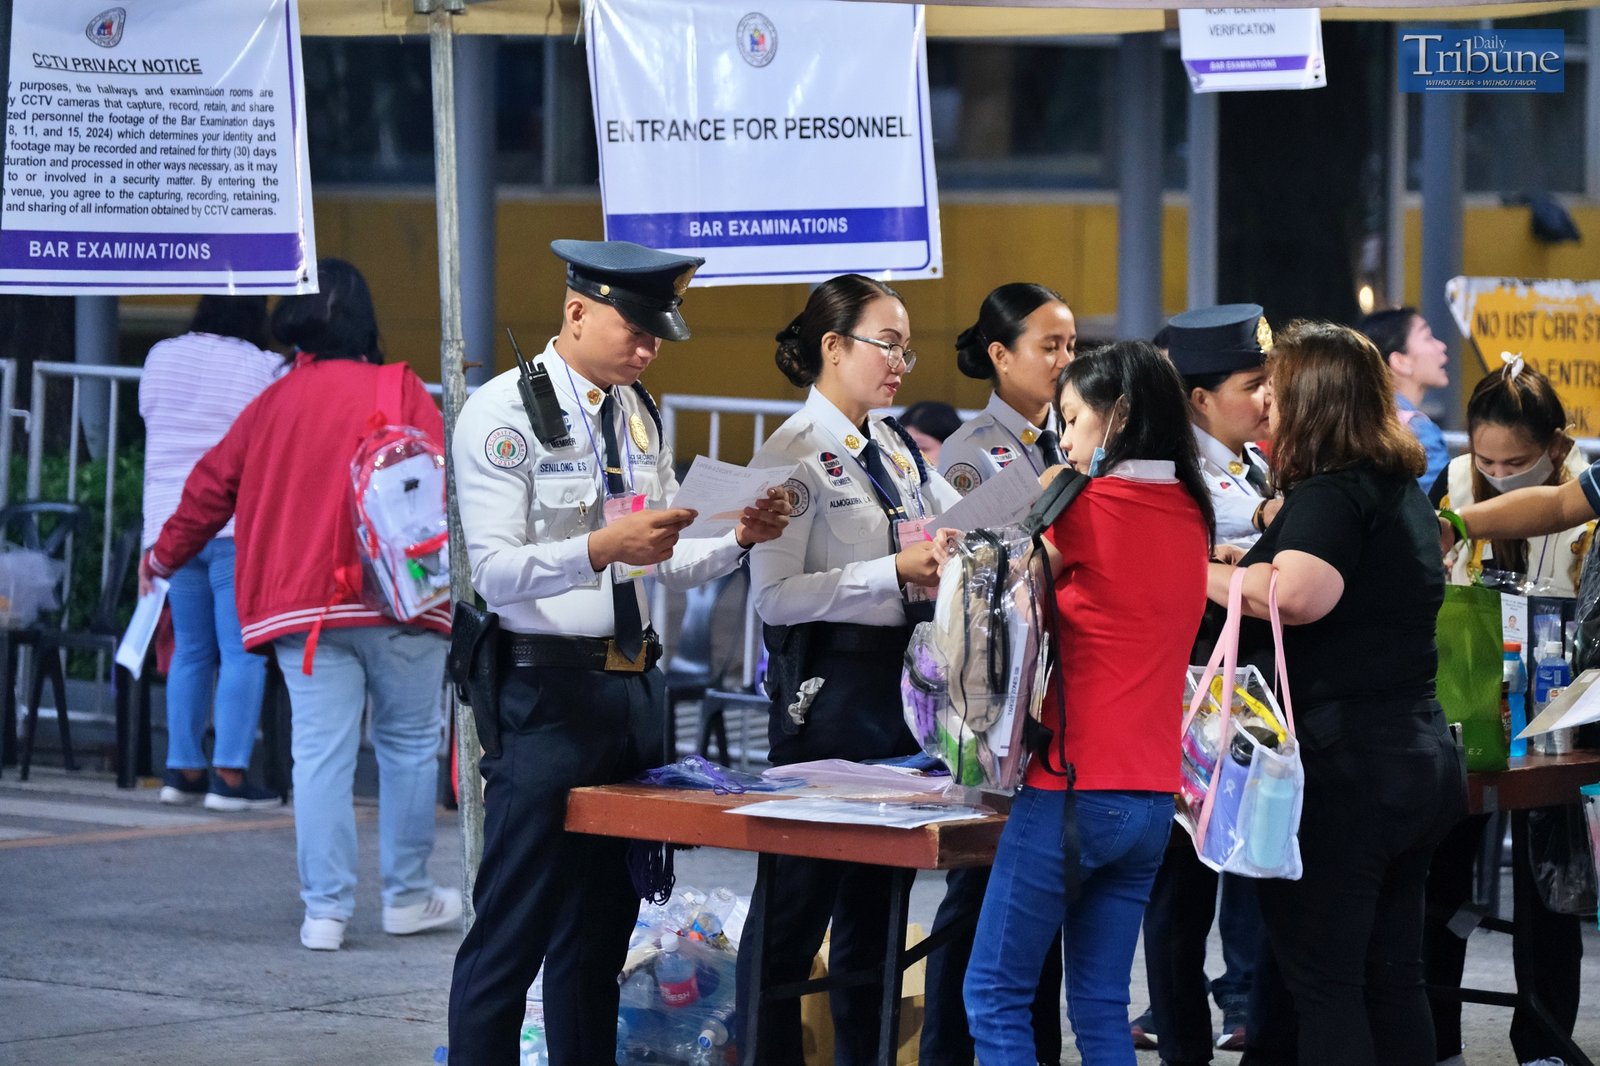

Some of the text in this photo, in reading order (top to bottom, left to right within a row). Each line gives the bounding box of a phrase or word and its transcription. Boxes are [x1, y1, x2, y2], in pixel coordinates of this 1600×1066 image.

[1209, 23, 1276, 36] VERIFICATION
[32, 53, 202, 73] CCTV PRIVACY NOTICE
[1209, 59, 1277, 71] BAR EXAMINATIONS
[20, 81, 71, 93] purposes,
[76, 83, 91, 93] the
[97, 84, 138, 97] hallways
[144, 86, 164, 96] and
[170, 86, 224, 97] examination
[229, 88, 253, 97] rooms
[260, 89, 274, 97] are
[21, 94, 52, 106] CCTV
[57, 98, 100, 108] cameras
[104, 98, 123, 109] that
[126, 100, 165, 112] capture,
[169, 100, 200, 112] record,
[204, 101, 228, 112] retain,
[231, 102, 245, 112] and
[249, 102, 274, 112] share
[32, 112, 83, 122] personnel
[88, 113, 104, 123] the
[109, 113, 144, 126] footage
[149, 114, 159, 125] of
[162, 114, 176, 125] the
[181, 115, 196, 126] Bar
[200, 115, 248, 126] Examination
[252, 117, 275, 129] days
[606, 116, 910, 142] ENTRANCE FOR PERSONNEL
[9, 125, 276, 144] 8, 11, and 15, 2024) which determines your identity and
[10, 141, 276, 159] footage may be recorded and retained for thirty (30) days
[50, 157, 68, 167] and
[71, 158, 123, 169] processed
[125, 159, 134, 169] in
[136, 160, 160, 170] other
[163, 161, 186, 173] ways
[188, 162, 231, 173] necessary,
[234, 163, 245, 171] as
[247, 161, 254, 171] it
[256, 163, 278, 173] may
[8, 171, 279, 188] to or involved in a security matter. By entering the
[11, 188, 45, 198] venue,
[50, 189, 69, 200] you
[73, 190, 101, 200] agree
[105, 189, 115, 199] to
[119, 189, 134, 199] the
[138, 190, 183, 202] capturing,
[187, 190, 229, 203] recording,
[233, 191, 279, 204] retaining,
[6, 202, 277, 218] and sharing of all information obtained by CCTV cameras.
[689, 217, 848, 237] BAR EXAMINATIONS
[29, 240, 212, 260] BAR EXAMINATIONS
[1477, 312, 1500, 337] NO
[1505, 312, 1537, 339] UST
[1542, 312, 1579, 341] CAR
[1548, 360, 1600, 387] ENTR
[550, 437, 577, 449] MEMBER
[540, 461, 587, 473] SENILONG ES
